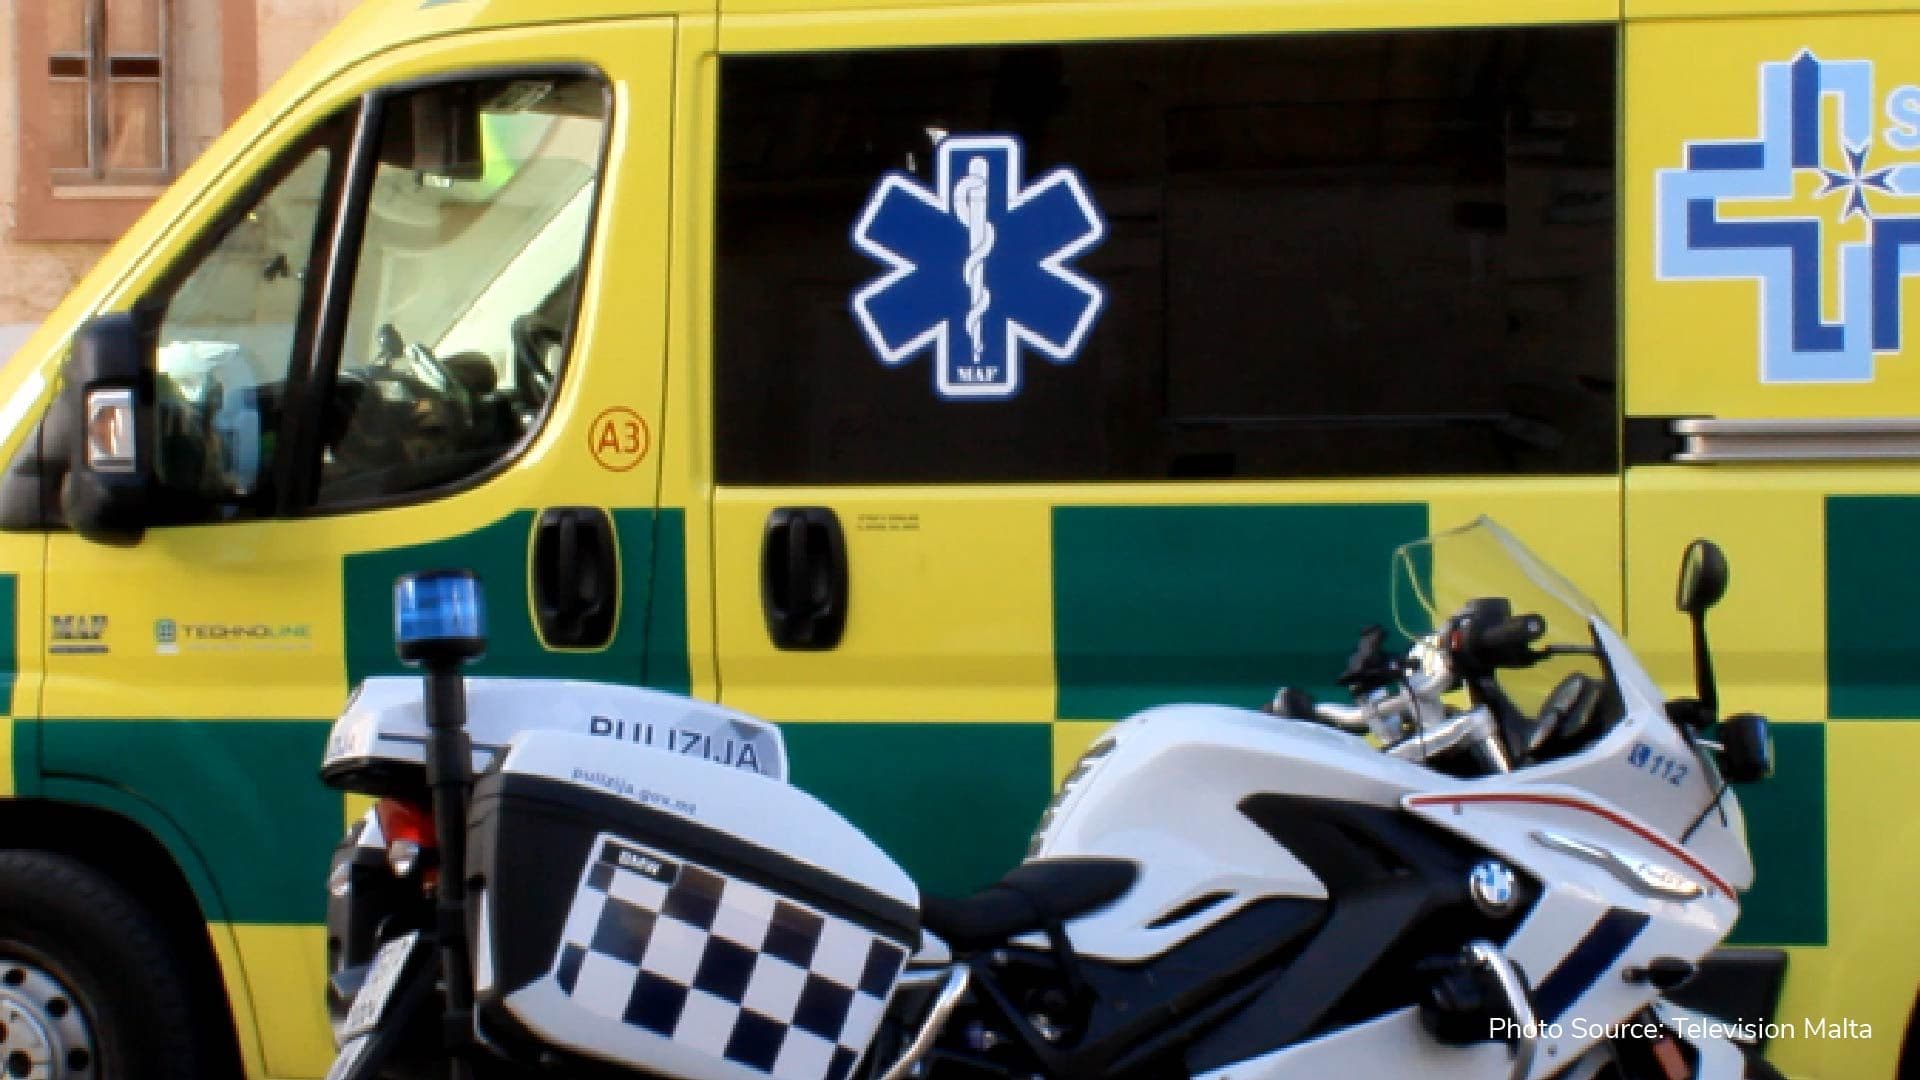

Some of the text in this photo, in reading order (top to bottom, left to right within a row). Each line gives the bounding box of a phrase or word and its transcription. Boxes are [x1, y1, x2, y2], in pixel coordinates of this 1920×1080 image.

[957, 366, 998, 382] MAF
[598, 420, 640, 453] A3
[183, 624, 312, 639] TECHNOLINE
